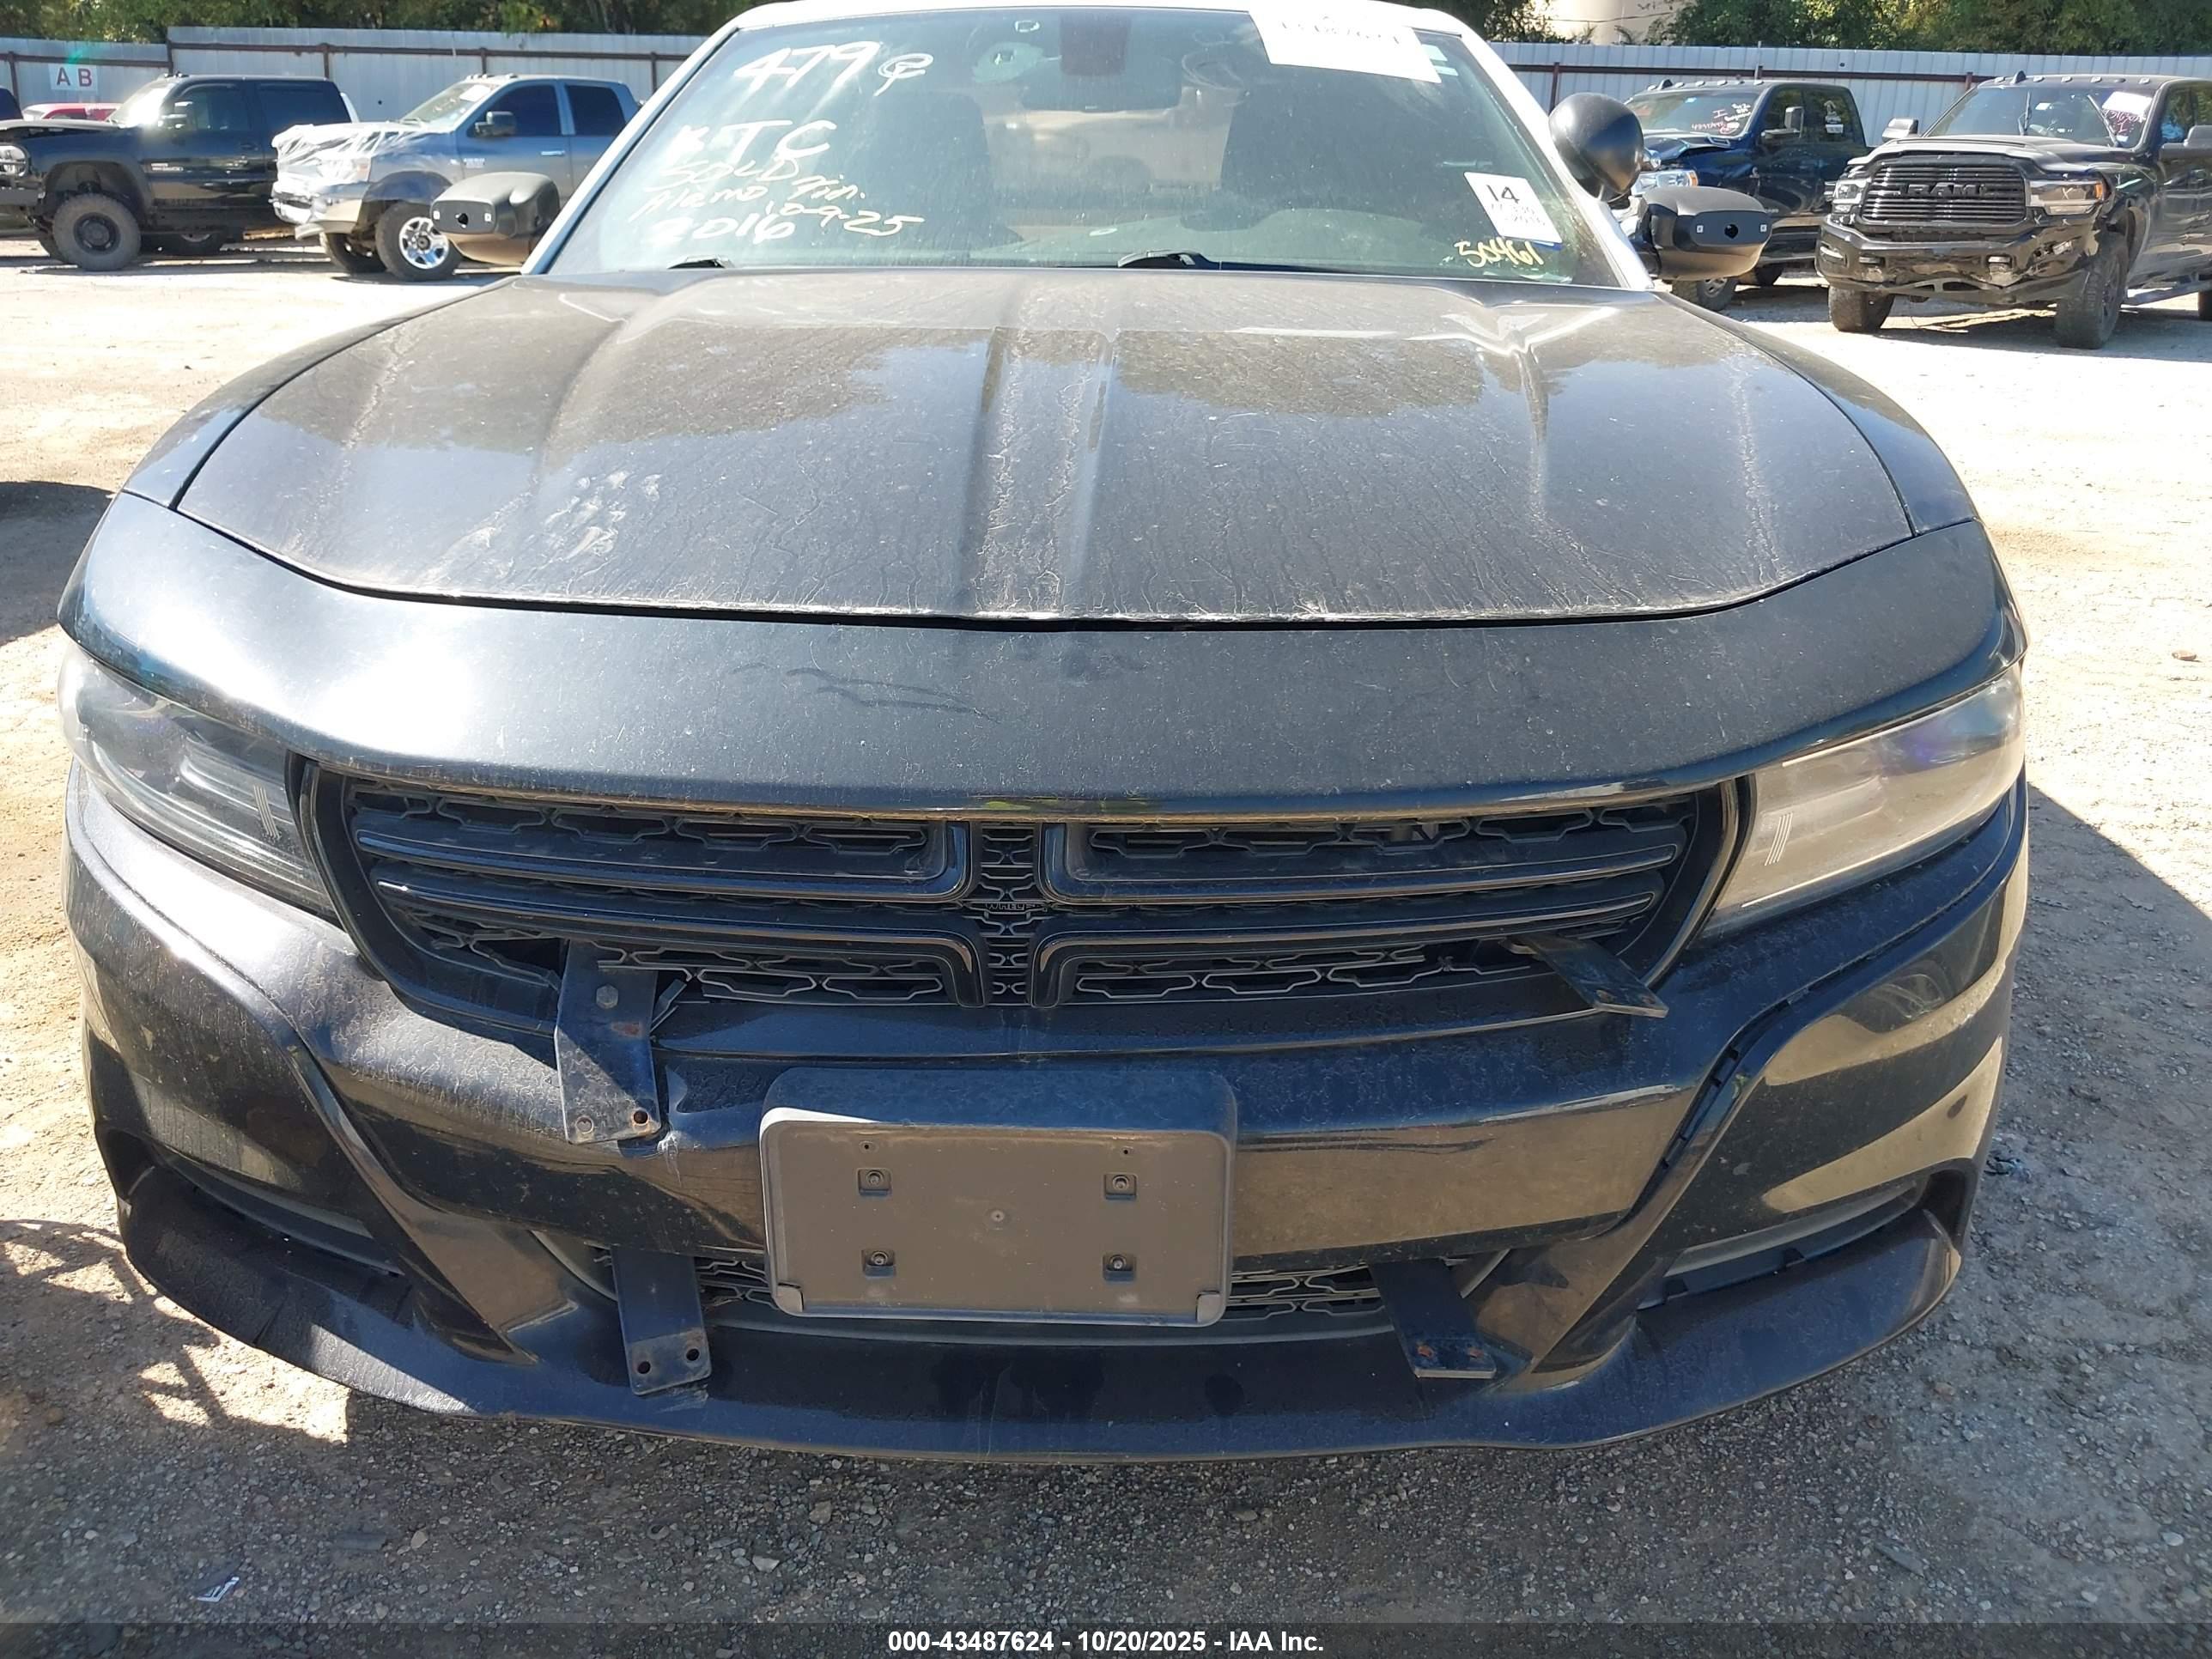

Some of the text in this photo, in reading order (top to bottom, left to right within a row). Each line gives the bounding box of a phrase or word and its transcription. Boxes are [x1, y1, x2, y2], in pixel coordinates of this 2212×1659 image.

[57, 67, 93, 87] A B
[732, 40, 883, 94] 479
[1486, 184, 1520, 204] 14
[1907, 182, 1977, 198] RAM
